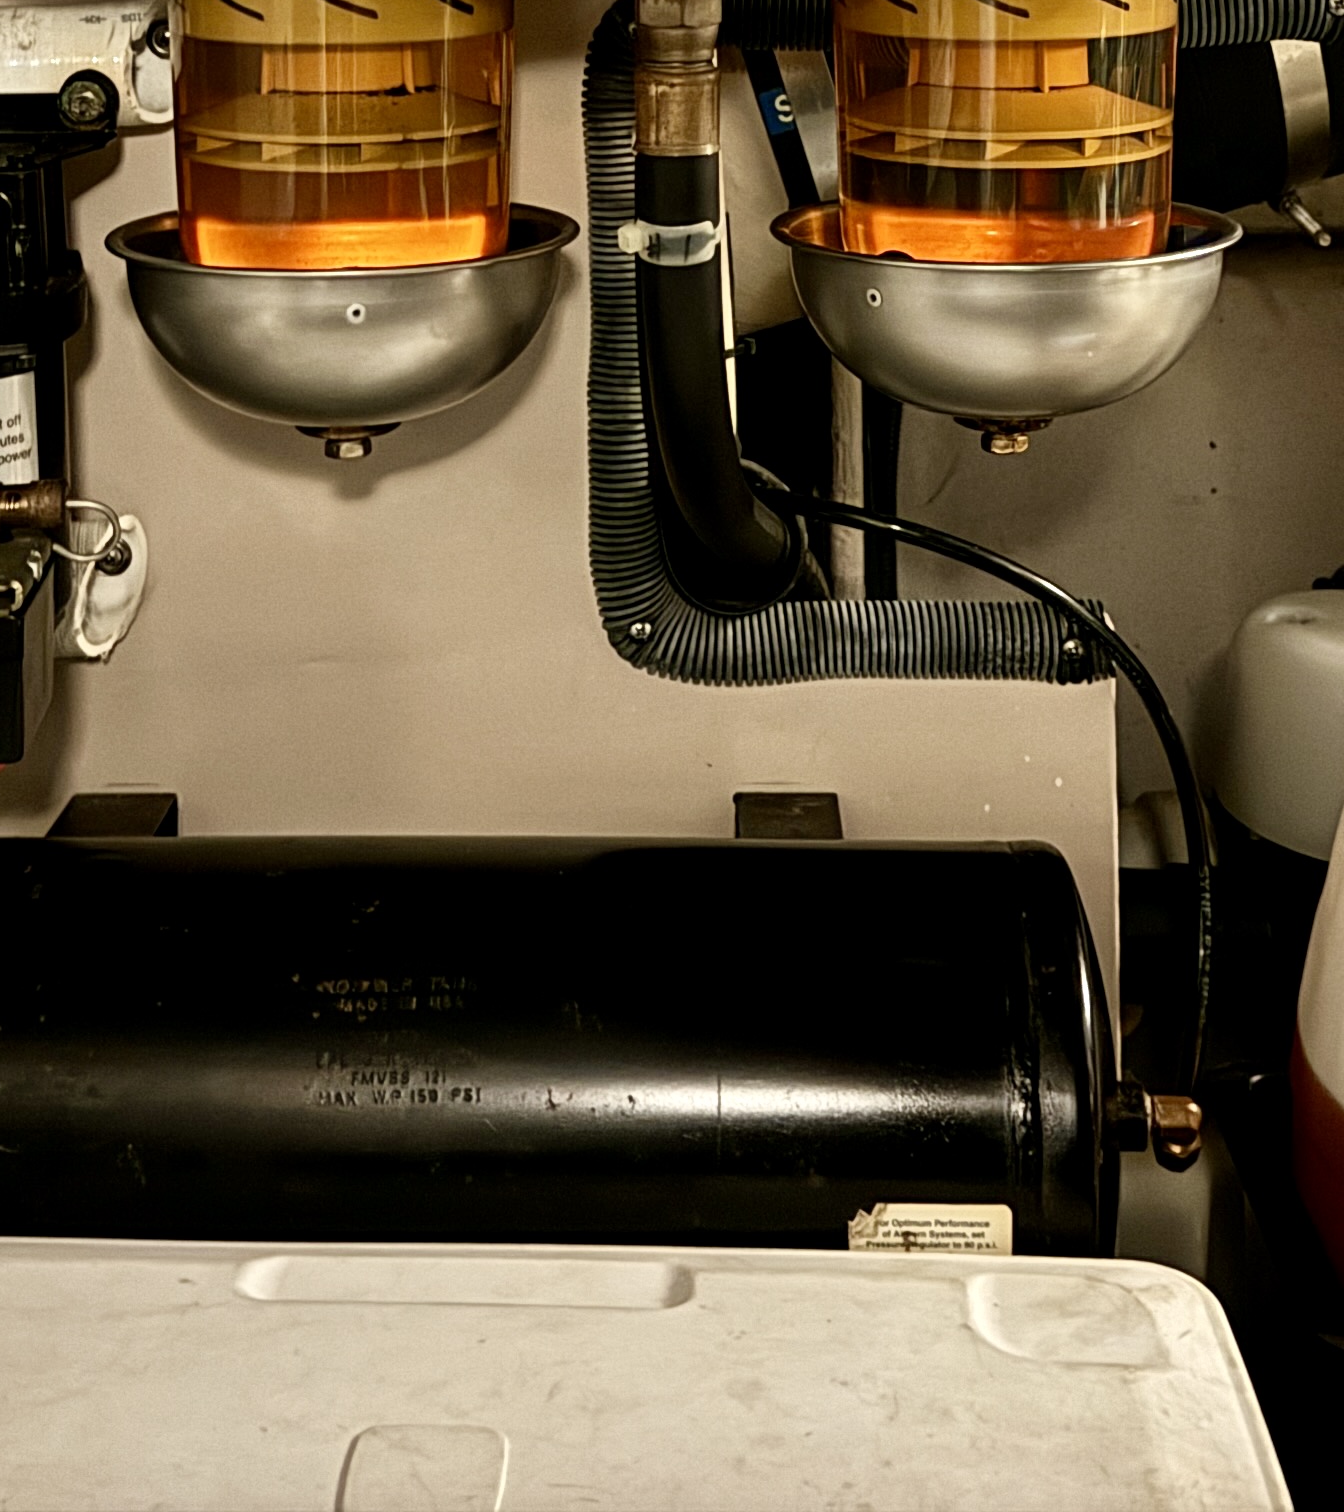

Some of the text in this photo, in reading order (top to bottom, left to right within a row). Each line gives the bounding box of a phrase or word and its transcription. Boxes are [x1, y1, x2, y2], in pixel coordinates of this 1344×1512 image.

[774, 94, 794, 123] S
[7, 414, 21, 428] off
[450, 1086, 483, 1104] PSI
[891, 1218, 991, 1229] Optimum Performance
[882, 1230, 892, 1238] of
[971, 1231, 986, 1239] set
